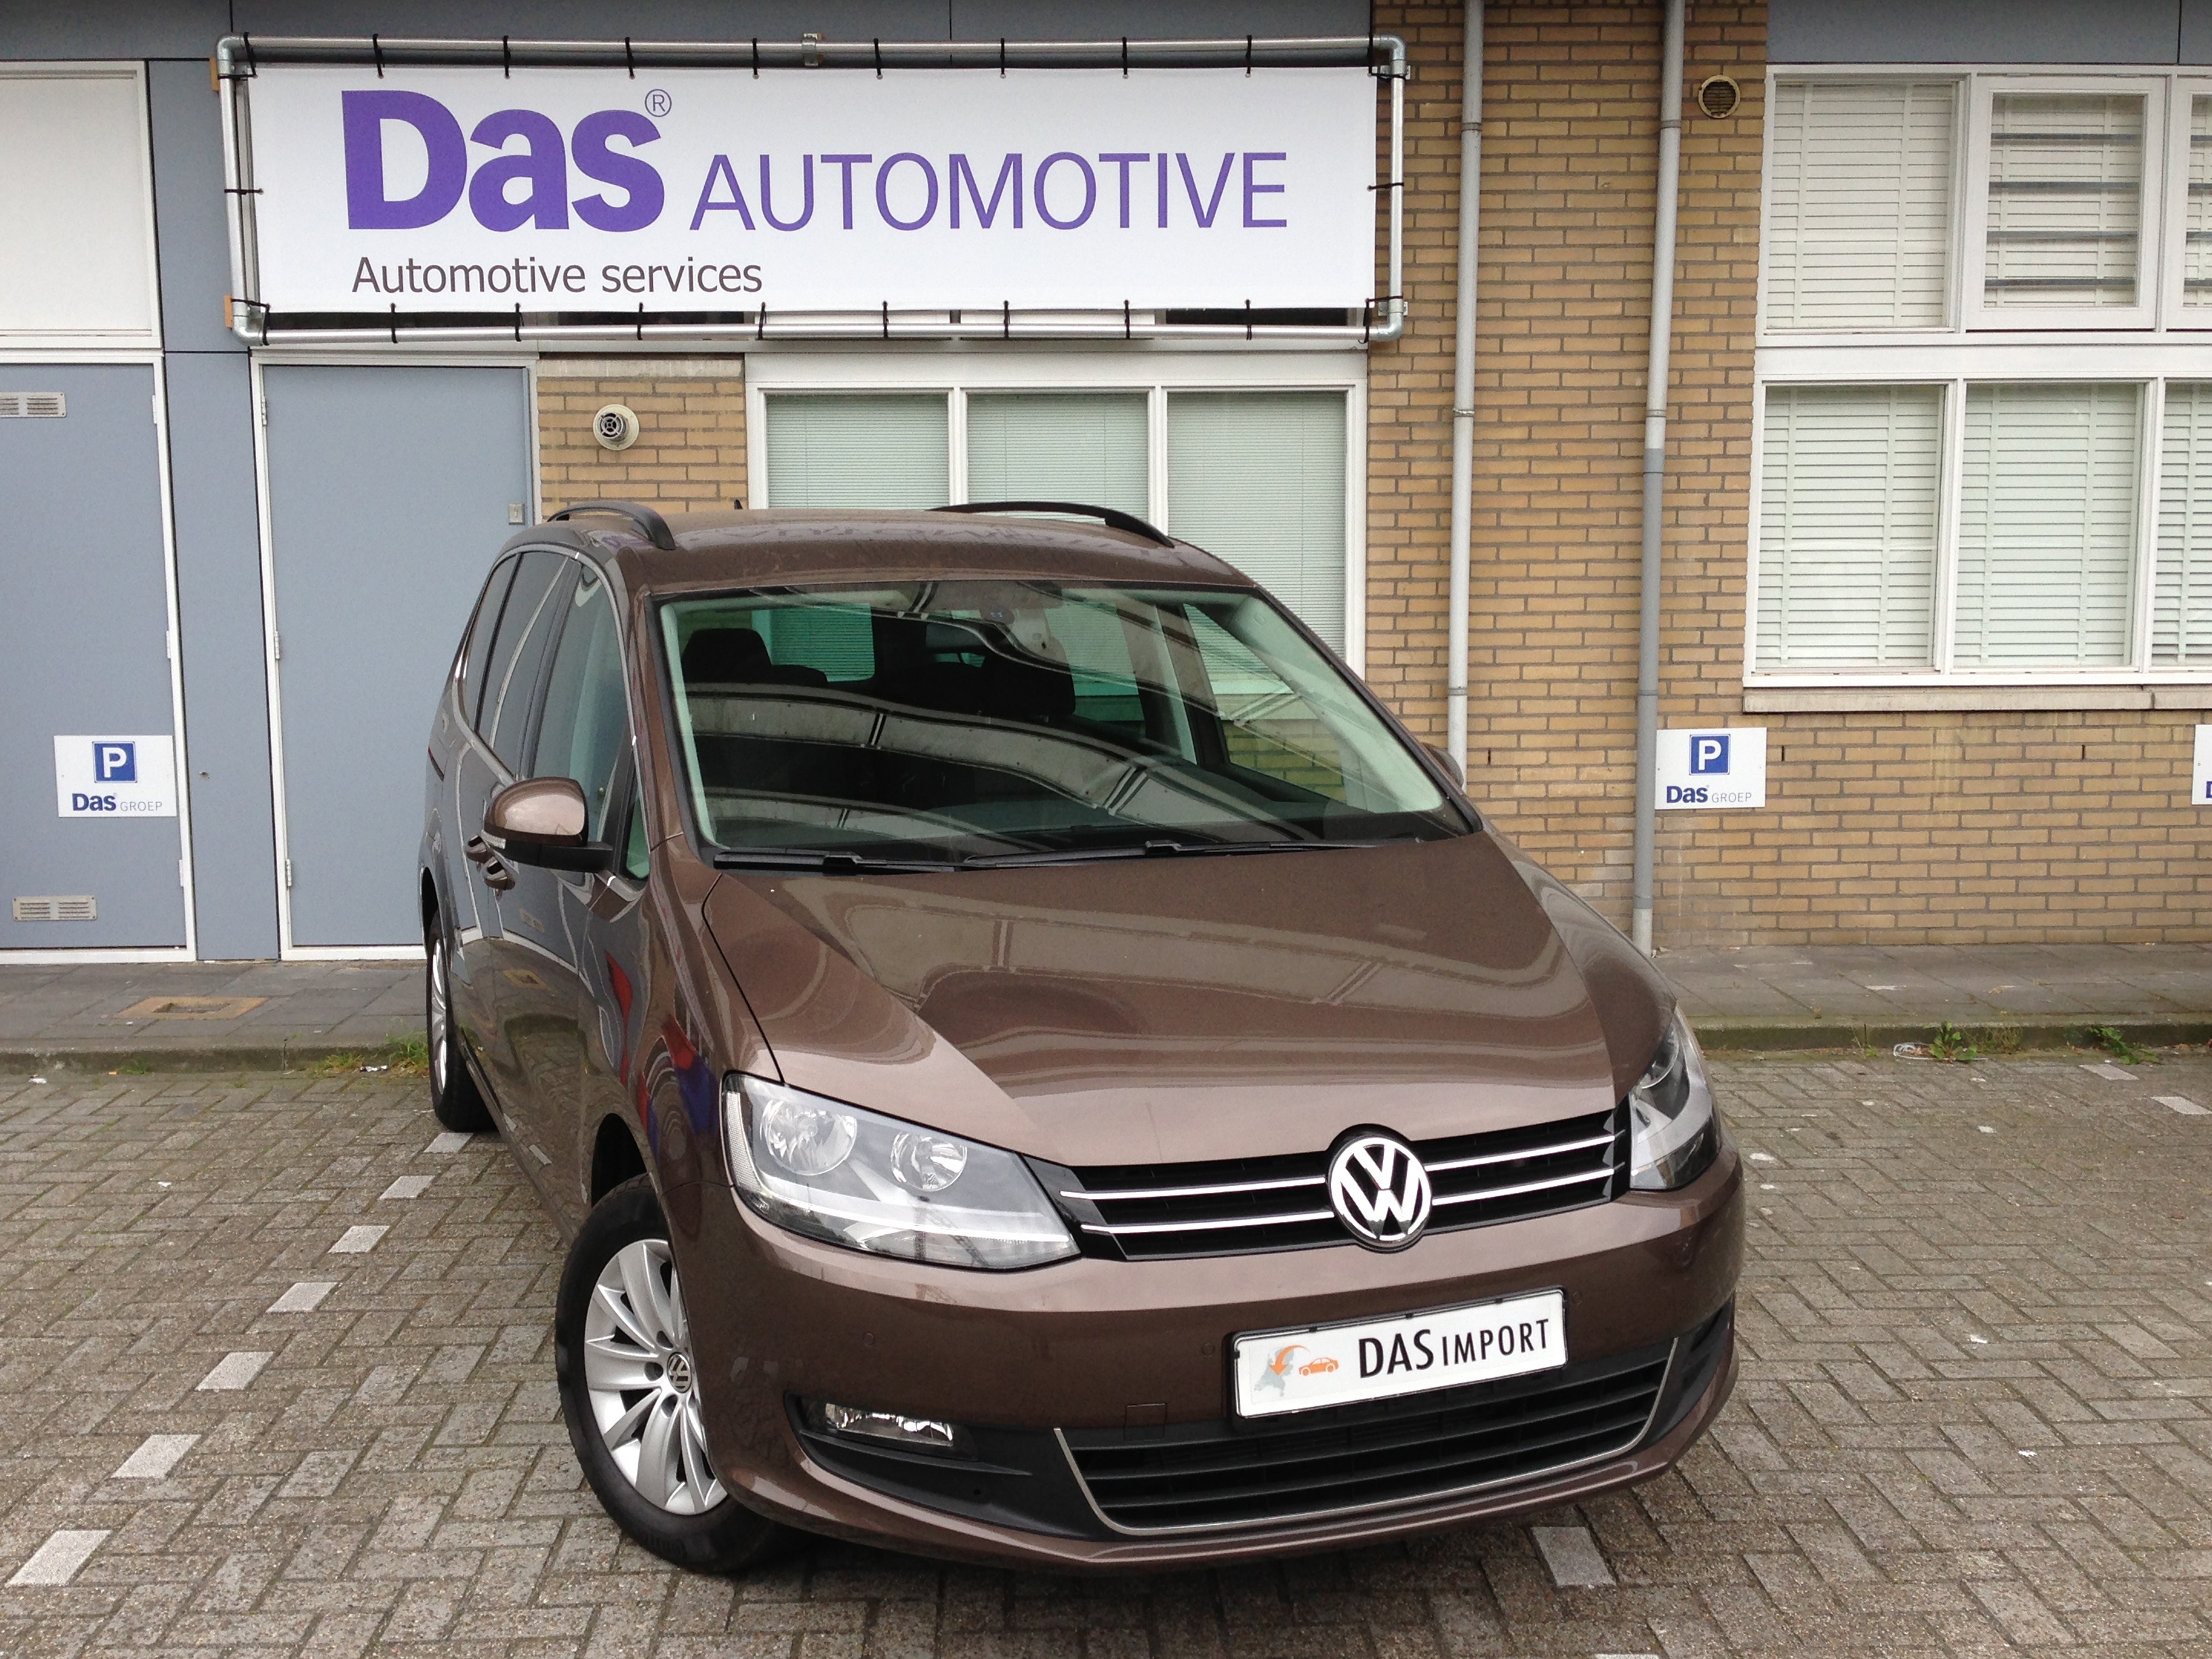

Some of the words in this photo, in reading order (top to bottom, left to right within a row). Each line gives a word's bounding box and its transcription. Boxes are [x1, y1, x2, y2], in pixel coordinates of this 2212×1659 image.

[689, 151, 1288, 232] AUTOMOTIVE
[352, 256, 586, 293] Automotive
[601, 256, 763, 293] services
[102, 747, 127, 778] P
[1698, 739, 1722, 771] P
[72, 793, 117, 811] Das
[119, 801, 163, 812] GROEP
[1666, 785, 1708, 804] Das
[1711, 792, 1753, 803] GROEP
[1358, 1329, 1434, 1378] DAS
[1442, 1318, 1549, 1366] IMPORT
